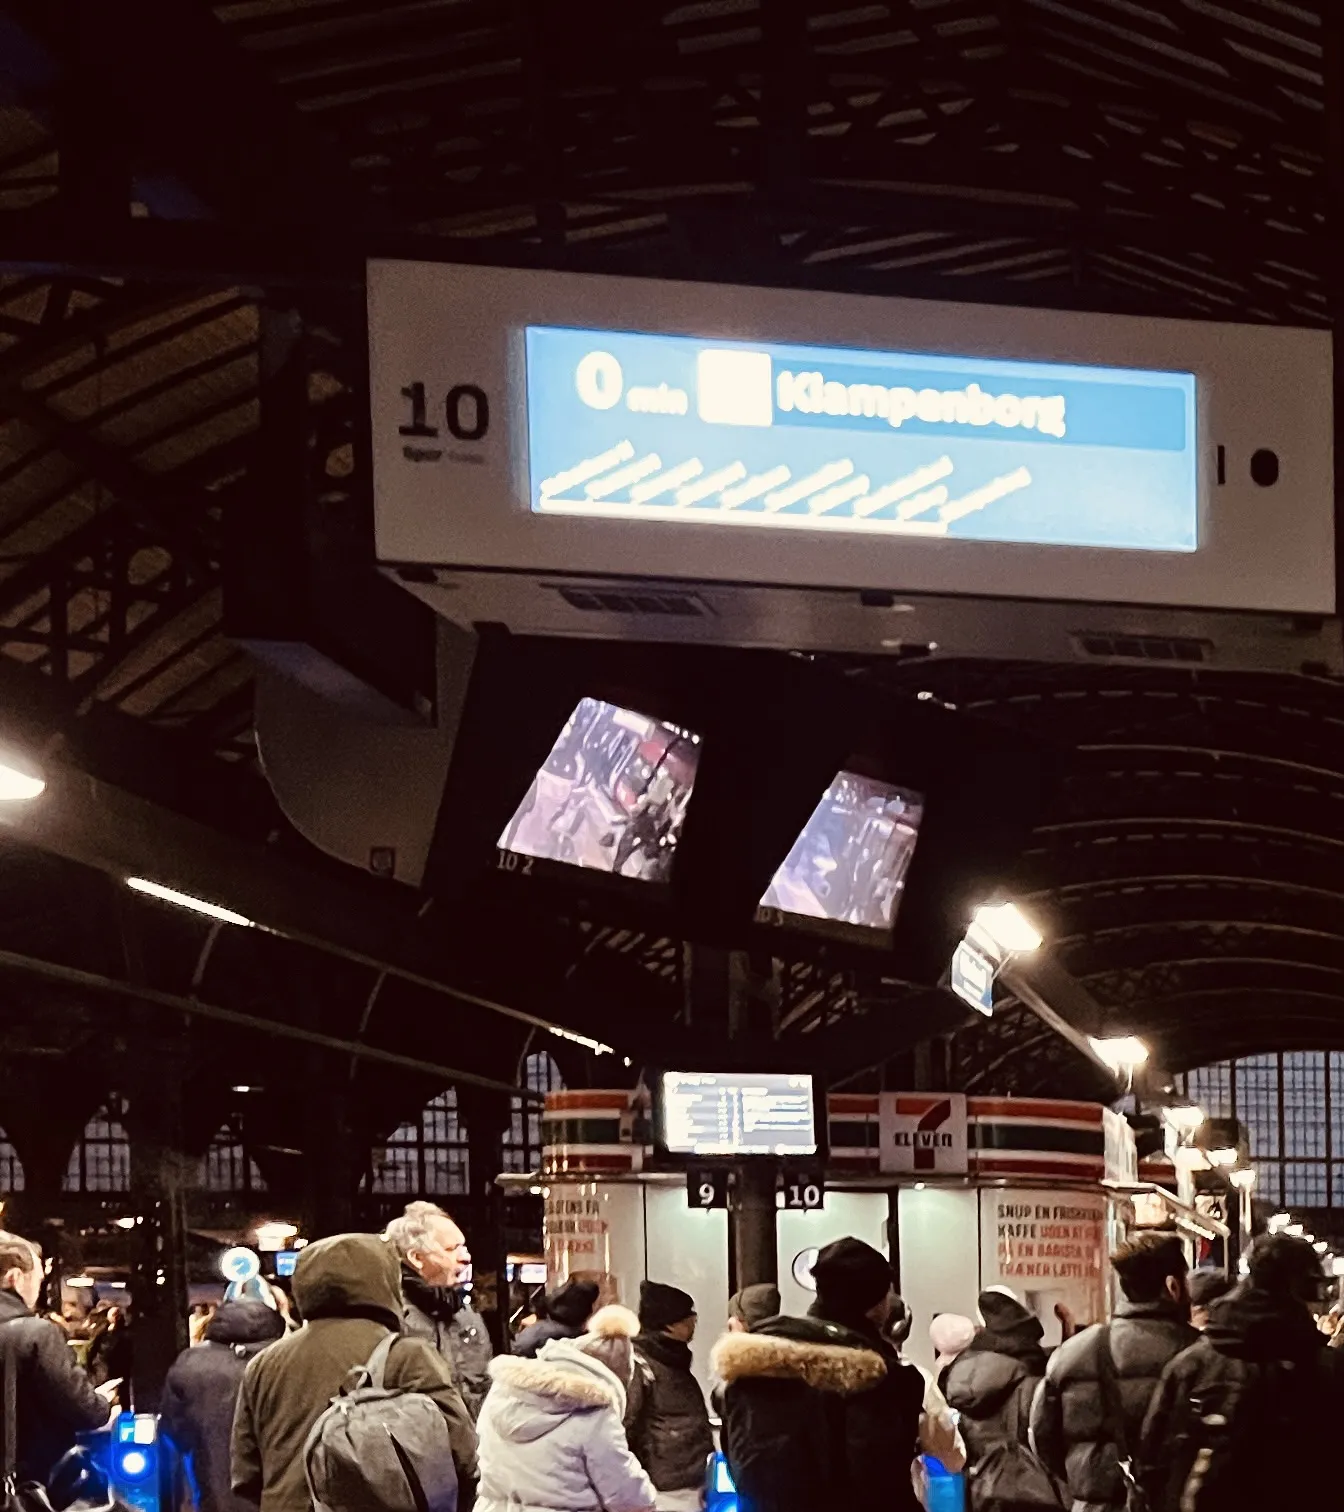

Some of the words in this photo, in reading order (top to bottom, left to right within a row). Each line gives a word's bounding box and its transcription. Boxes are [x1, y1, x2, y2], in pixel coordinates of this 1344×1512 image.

[576, 350, 623, 410] 0
[777, 370, 1066, 438] Klampenborg
[399, 382, 489, 441] 10
[699, 1183, 715, 1205] 9
[789, 1184, 820, 1207] 10
[998, 1223, 1036, 1238] KAFFE
